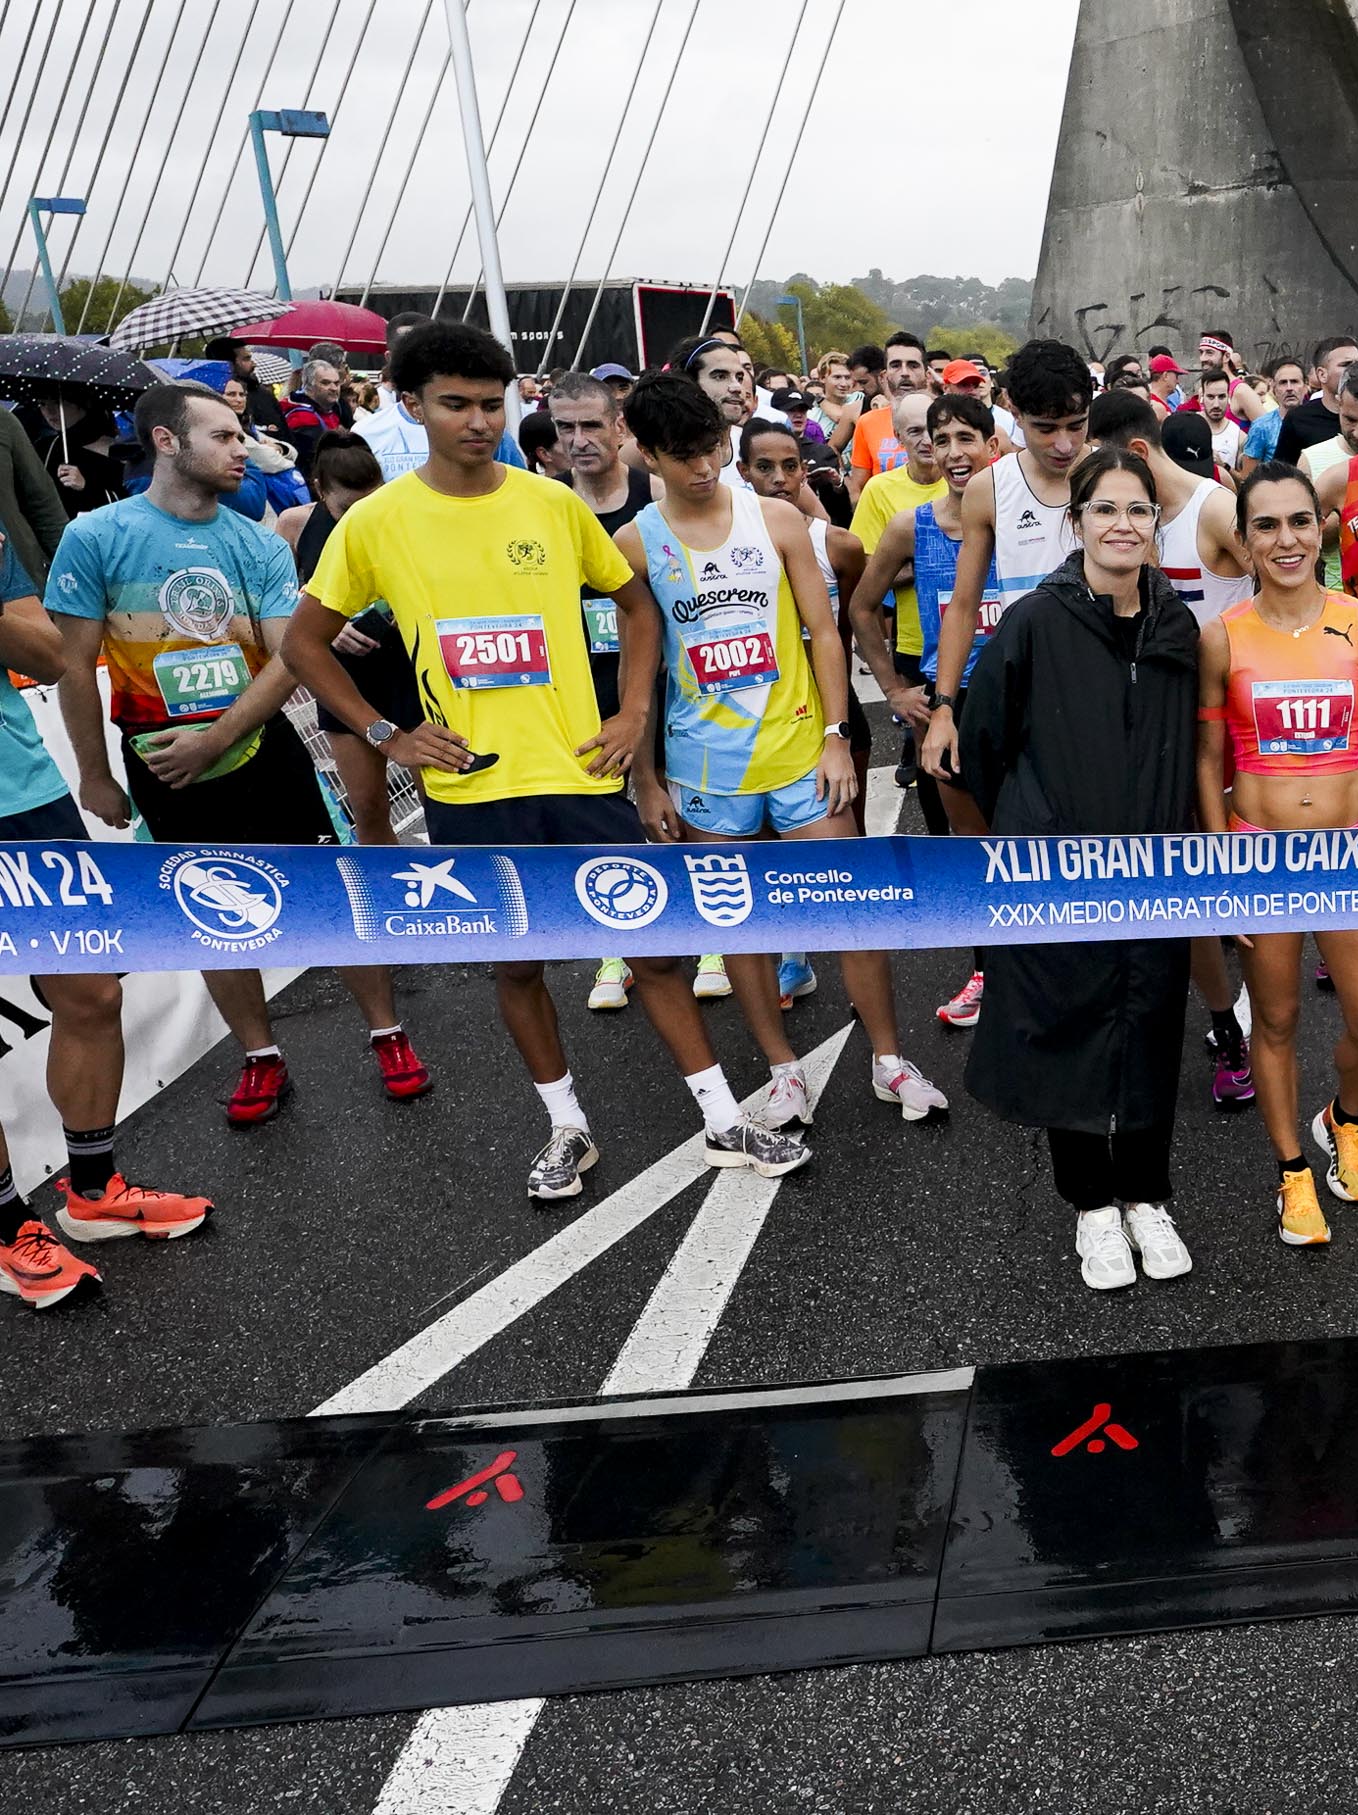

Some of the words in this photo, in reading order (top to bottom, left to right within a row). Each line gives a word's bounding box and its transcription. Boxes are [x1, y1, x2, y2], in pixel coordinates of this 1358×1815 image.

[672, 588, 769, 623] Quescrem
[456, 633, 532, 665] 2501
[699, 637, 765, 673] 2002
[173, 660, 239, 693] 2279
[1276, 699, 1331, 729] 1111
[159, 850, 197, 890] SOCIEDAD
[588, 862, 648, 880] DEPORTE
[980, 839, 1051, 883] XLII
[1057, 837, 1155, 881] GRAN
[1163, 833, 1276, 877] FONDO
[41, 850, 114, 906] 24
[764, 869, 853, 885] Concello
[589, 888, 656, 920] PONTEVEDRA
[768, 889, 794, 905] de
[799, 886, 914, 904] Pontevedra
[987, 902, 1046, 927] XXIX
[1048, 900, 1125, 924] MEDIO
[1128, 890, 1250, 921] MARATÓN
[1253, 893, 1284, 916] DE
[191, 927, 284, 953] PONTEVEDRA
[384, 915, 498, 936] CaixaBank
